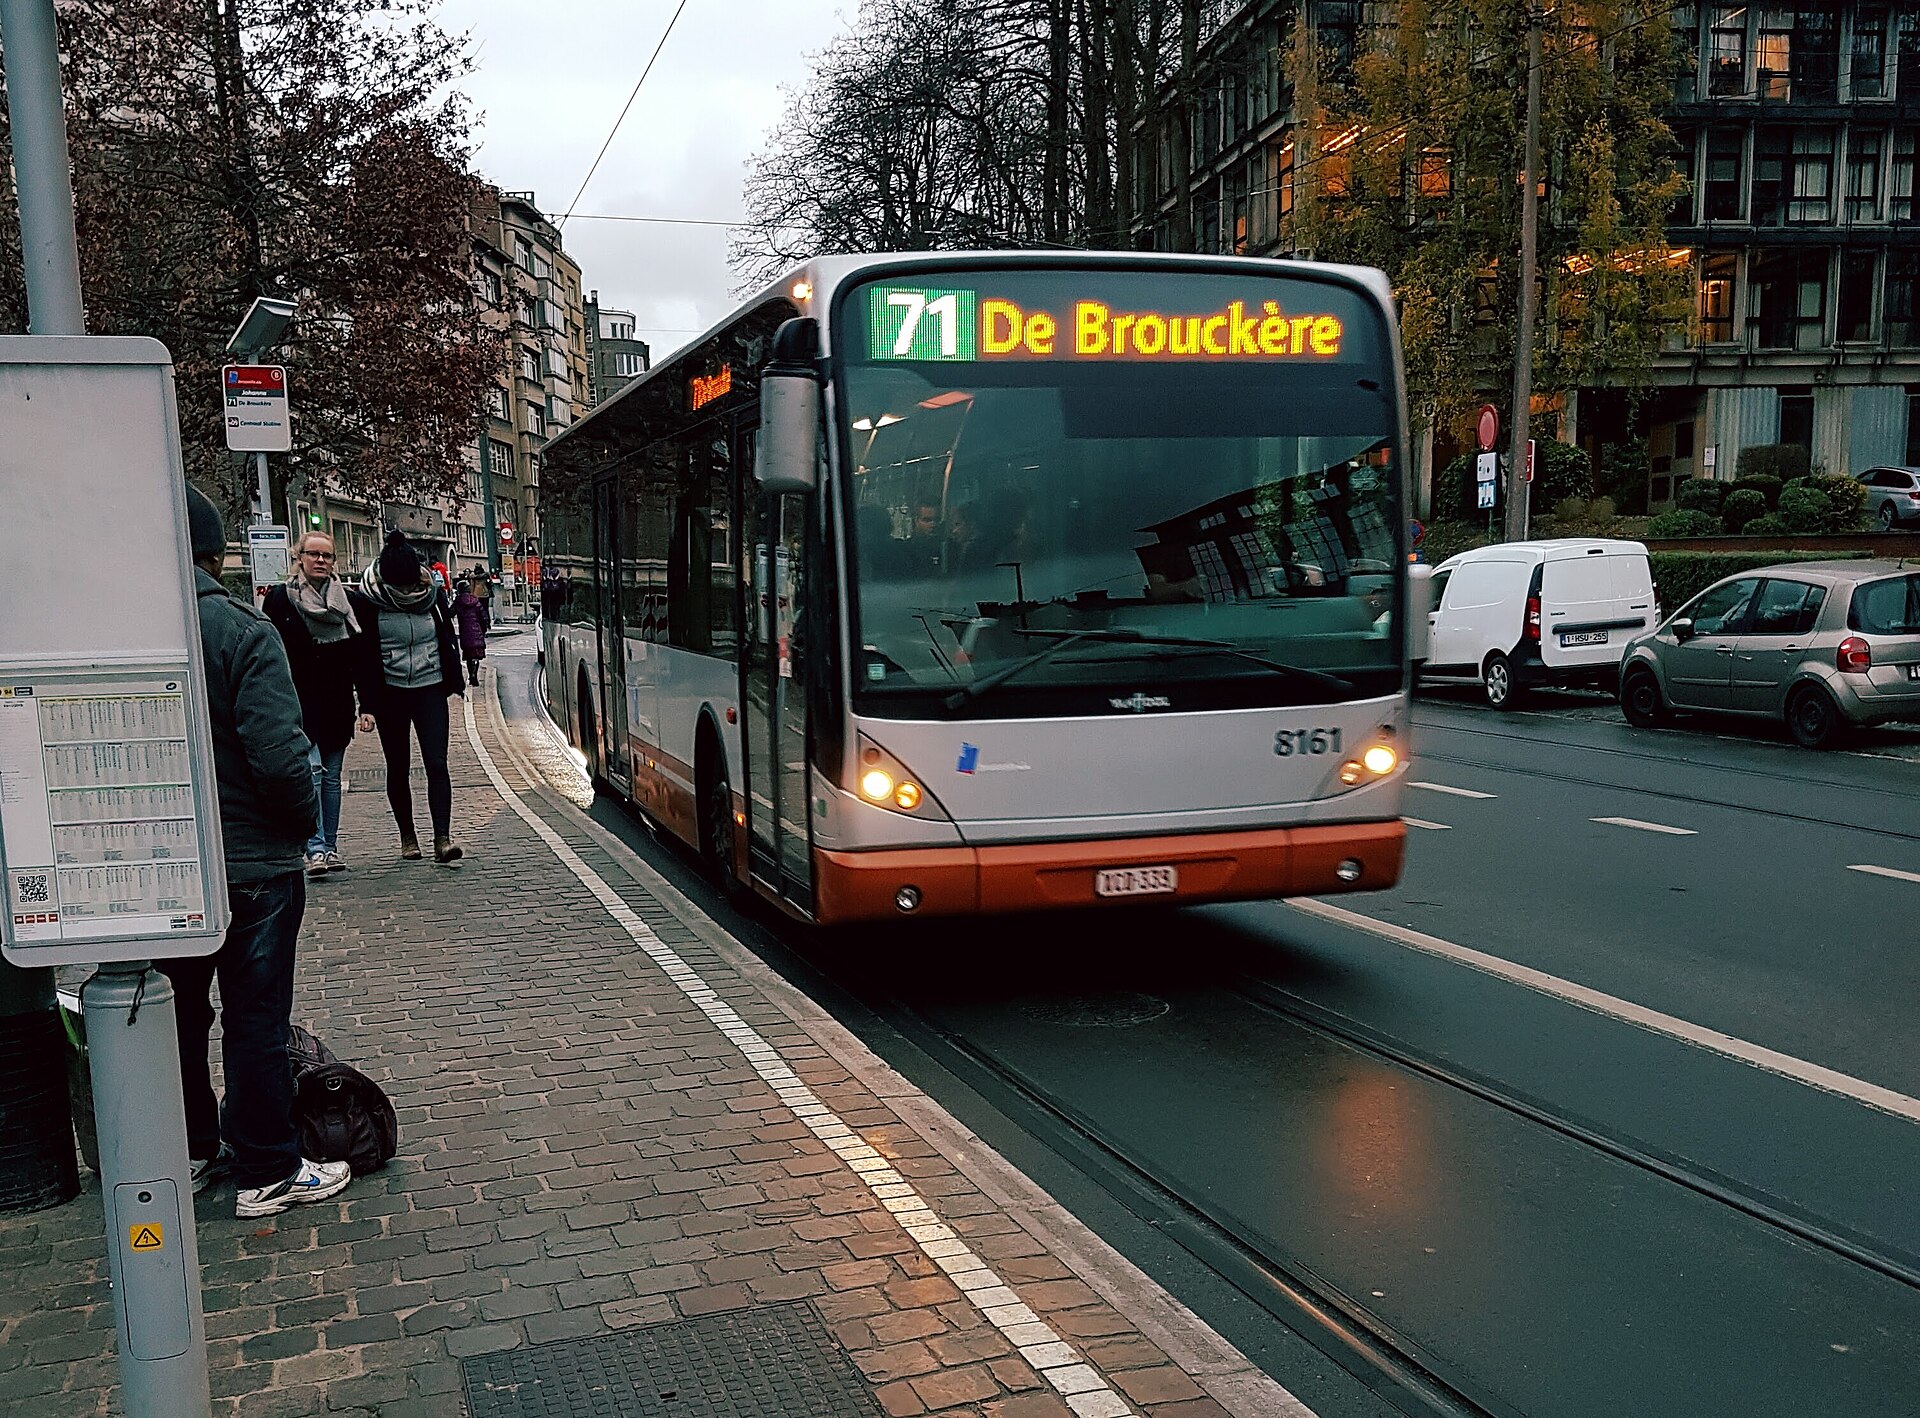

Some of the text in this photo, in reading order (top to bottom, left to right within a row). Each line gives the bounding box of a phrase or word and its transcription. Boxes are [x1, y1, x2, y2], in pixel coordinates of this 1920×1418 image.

[886, 292, 1344, 357] 71 De Brouckère
[1273, 726, 1343, 756] 8161
